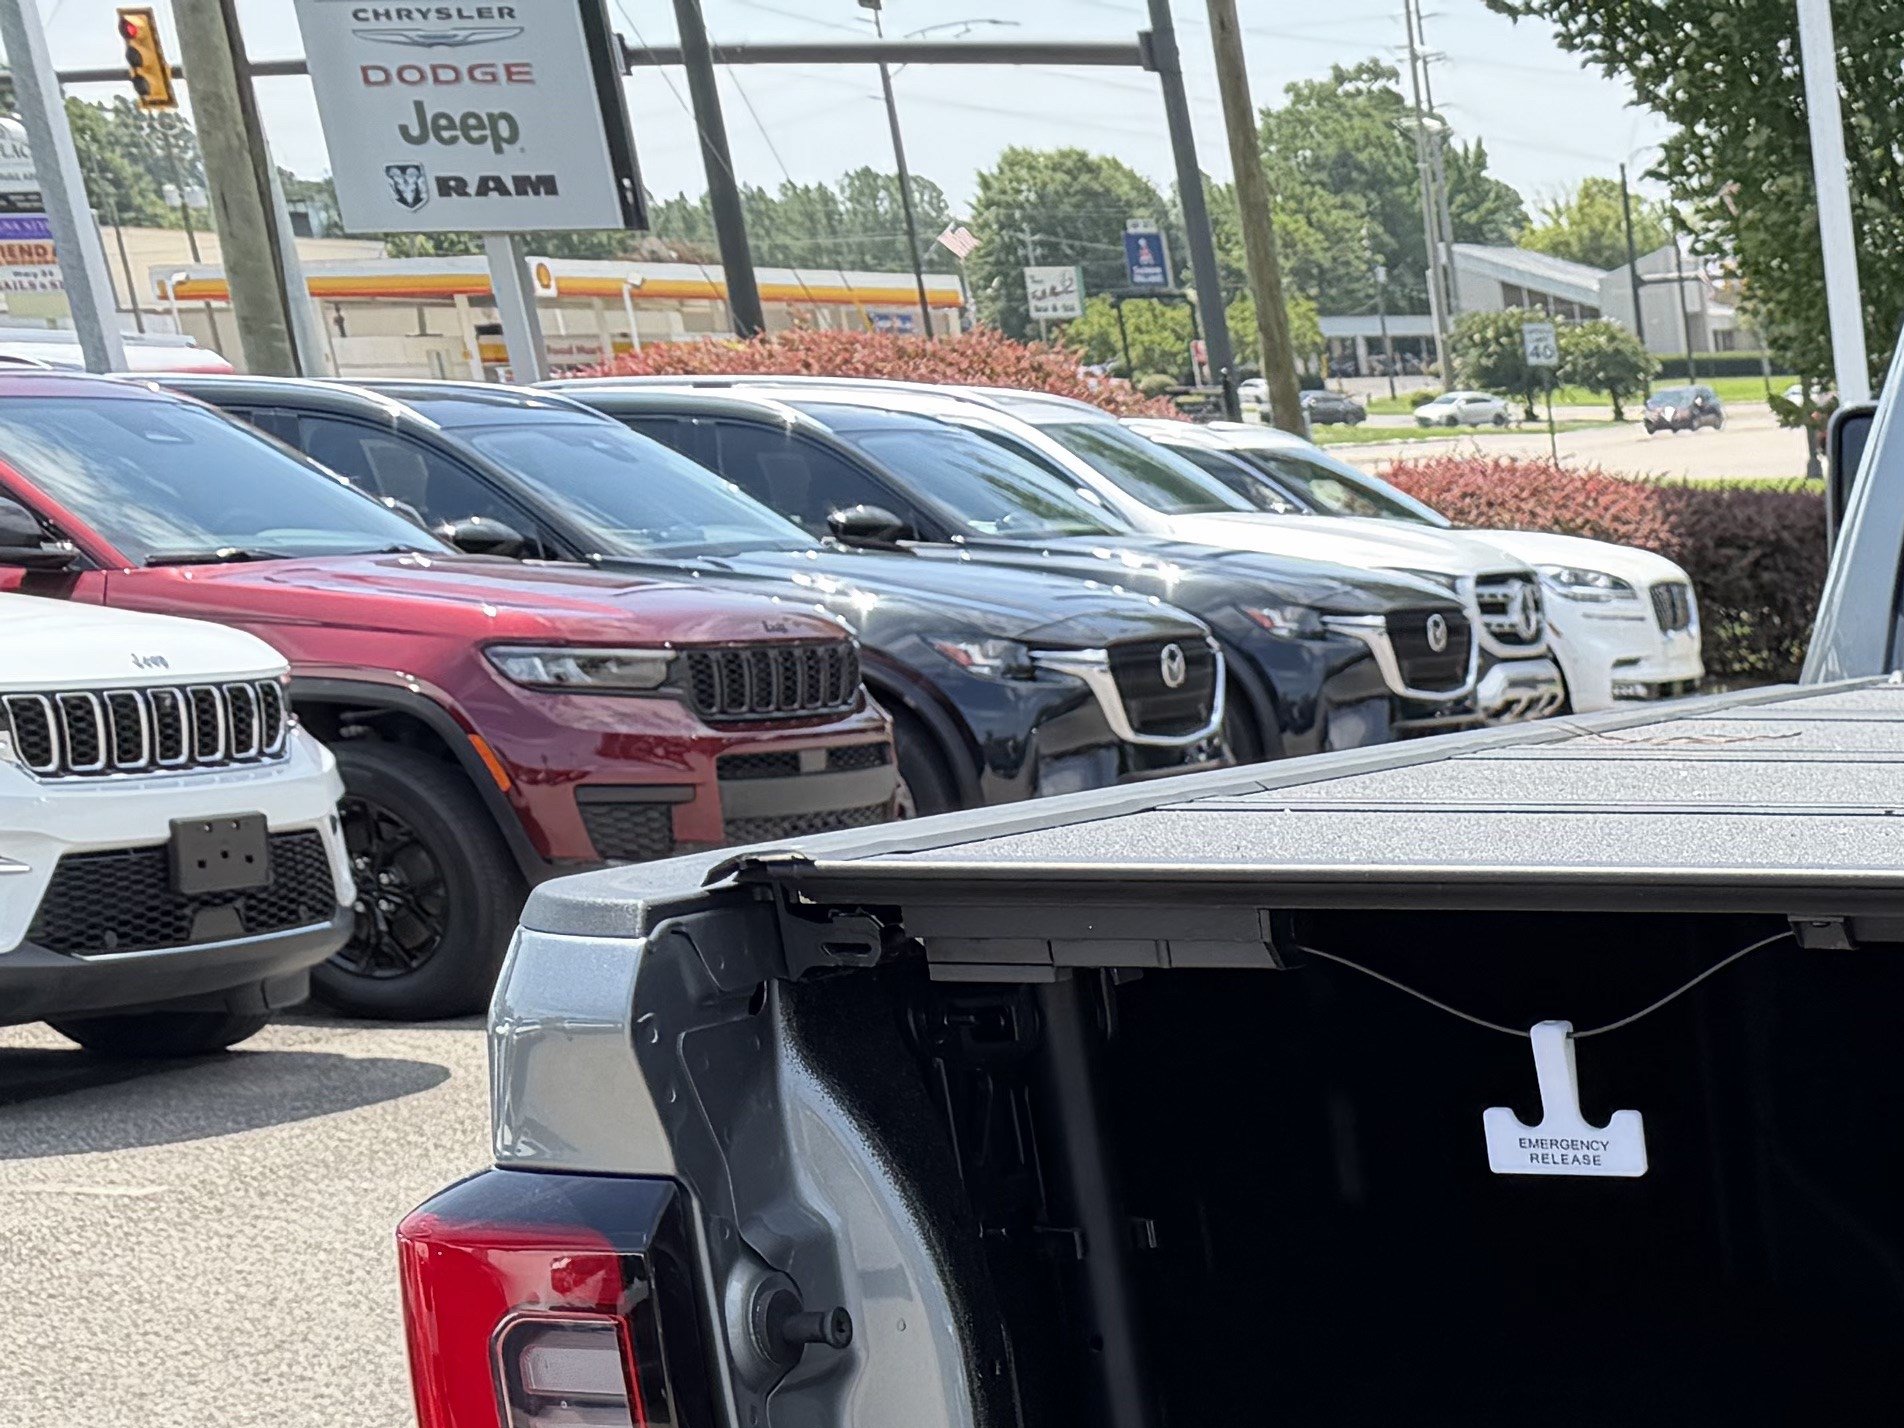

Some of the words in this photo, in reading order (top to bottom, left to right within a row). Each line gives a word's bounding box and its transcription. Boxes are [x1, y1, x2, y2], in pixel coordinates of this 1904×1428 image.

[352, 6, 516, 22] CHRYSLER
[360, 63, 536, 87] DODGE
[398, 100, 521, 155] Jeep
[434, 174, 559, 197] RAM
[1519, 1137, 1609, 1152] EMERGENCY
[1530, 1152, 1602, 1166] RELEASE
